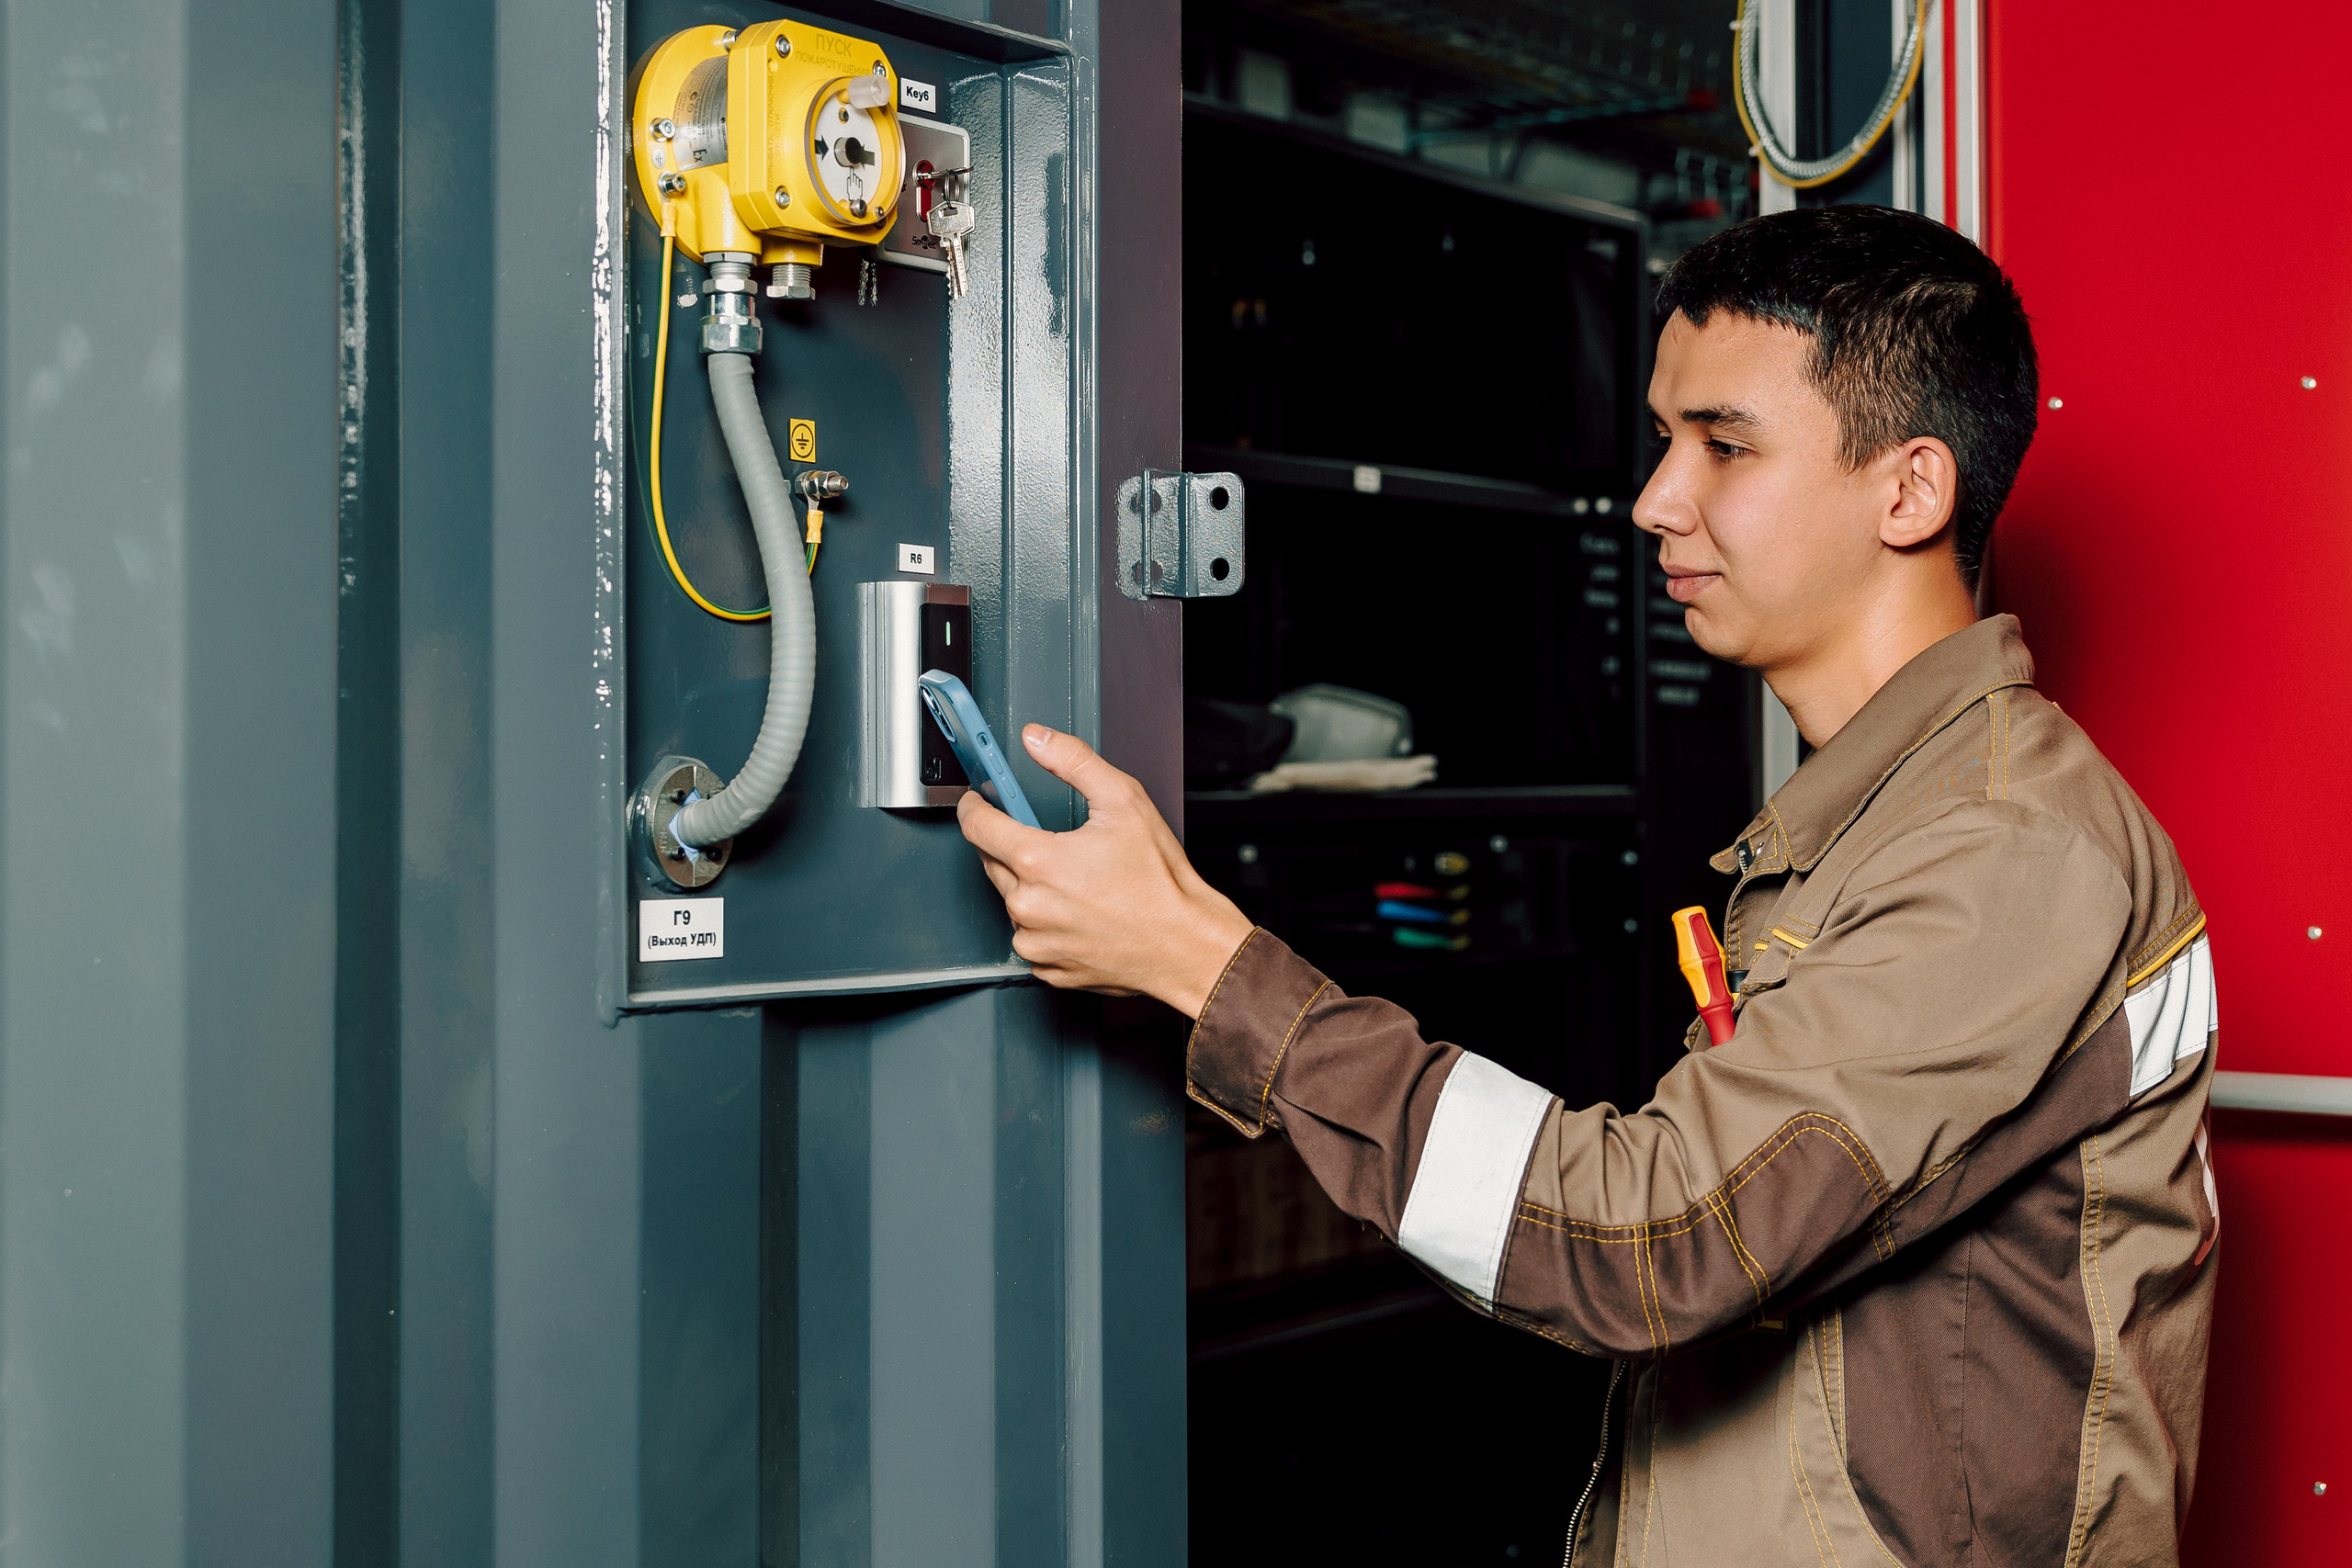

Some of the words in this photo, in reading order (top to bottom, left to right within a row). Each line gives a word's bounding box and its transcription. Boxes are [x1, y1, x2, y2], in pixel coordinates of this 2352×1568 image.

[816, 33, 853, 58] ПУСК
[796, 51, 871, 74] ПОЖАРОТУШЕНИЯ
[906, 85, 930, 102] Key6
[694, 148, 707, 163] Ex
[910, 552, 922, 564] R6
[673, 910, 691, 926] Г9
[648, 935, 687, 949] (Выход
[690, 932, 717, 946] УДП)
